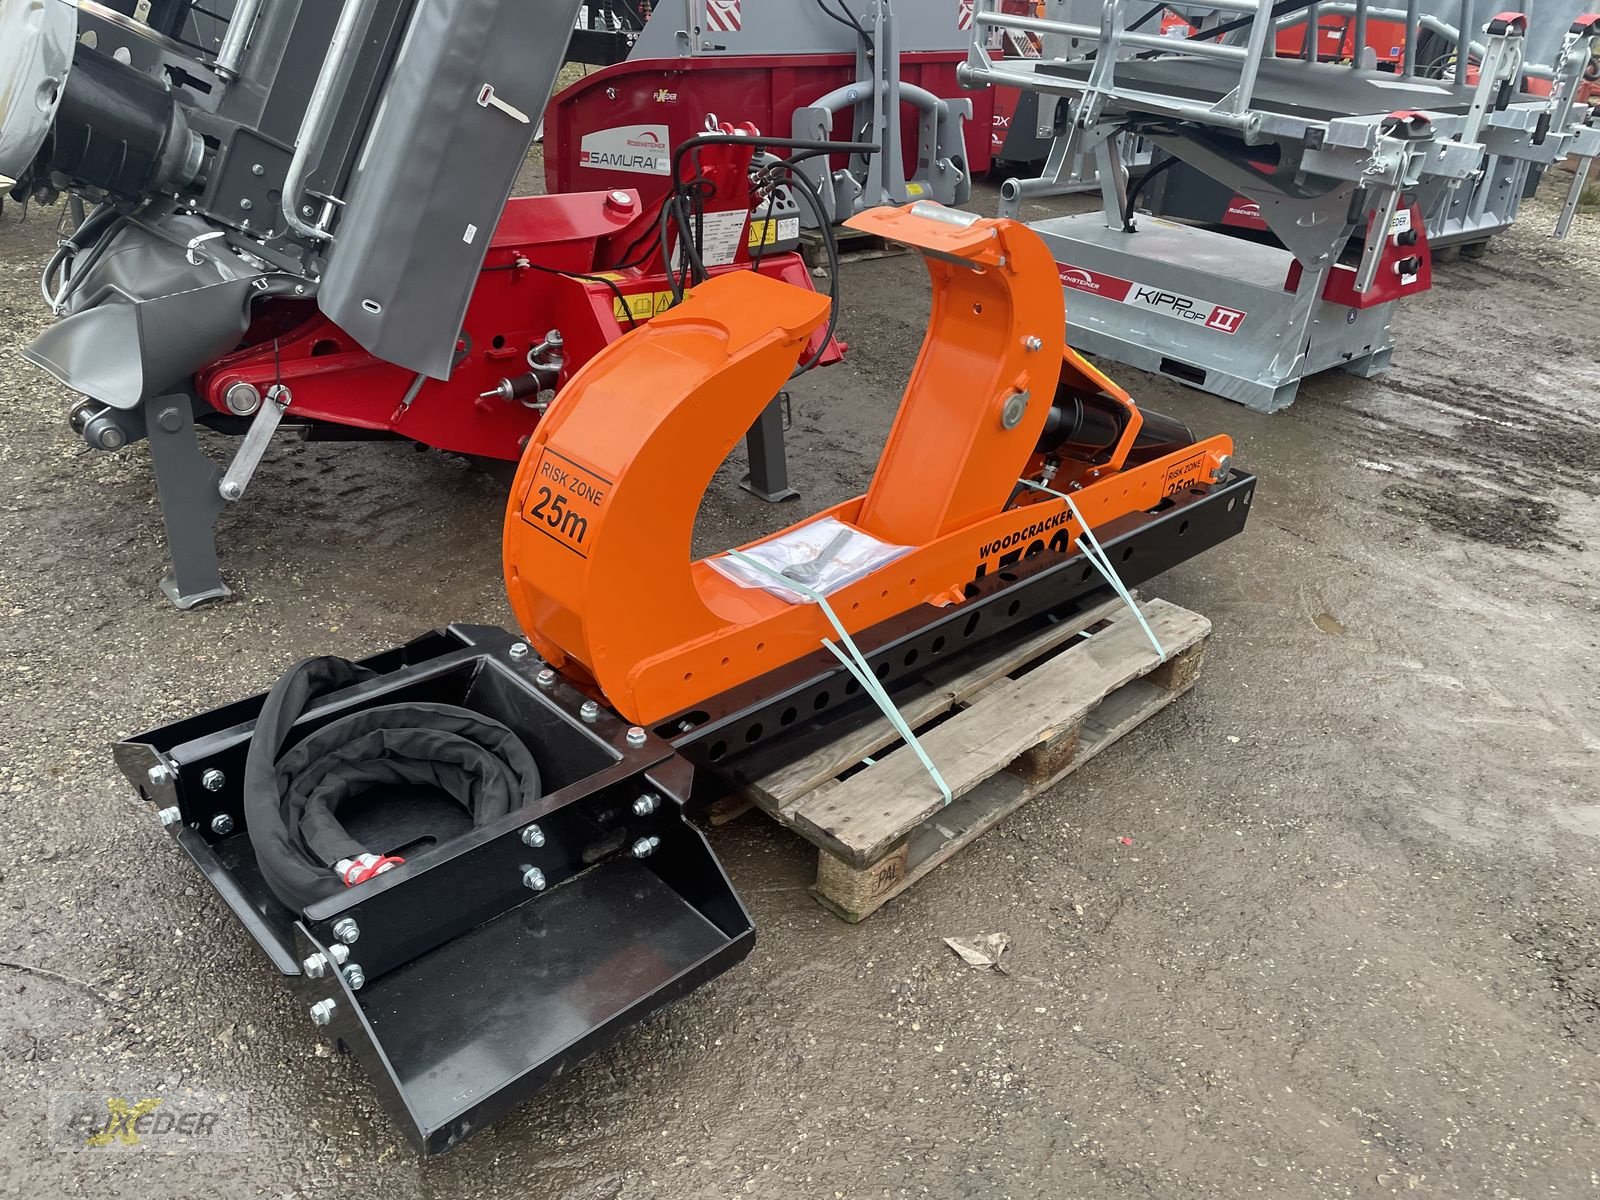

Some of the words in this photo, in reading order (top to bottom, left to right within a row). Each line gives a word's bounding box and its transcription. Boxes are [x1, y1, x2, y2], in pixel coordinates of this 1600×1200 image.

[590, 151, 658, 170] SAMURAI
[1391, 216, 1407, 228] EDER
[1059, 273, 1100, 290] SENSTEINER
[1134, 286, 1195, 311] KIPP
[1175, 306, 1206, 321] TOP
[541, 461, 570, 488] RISK
[568, 477, 604, 507] ZONE
[1167, 466, 1185, 481] RISK
[1183, 459, 1202, 474] ZONE
[530, 486, 588, 545] 25m
[979, 508, 1075, 560] WOODCRACKER
